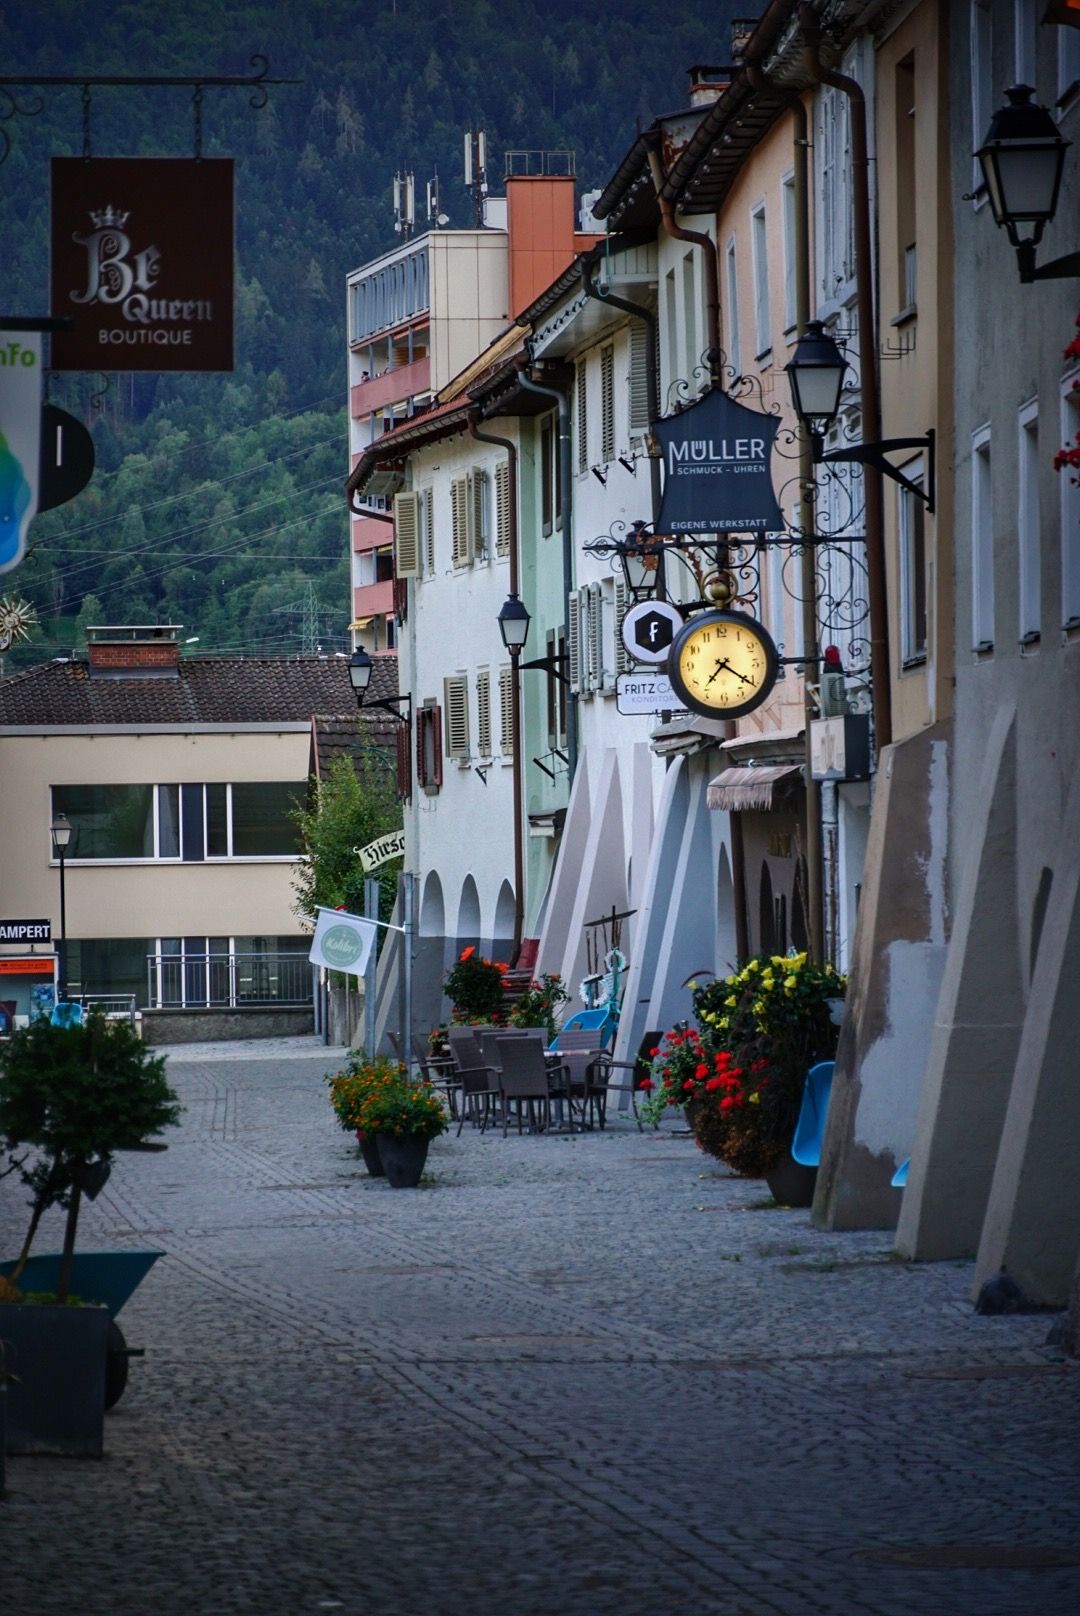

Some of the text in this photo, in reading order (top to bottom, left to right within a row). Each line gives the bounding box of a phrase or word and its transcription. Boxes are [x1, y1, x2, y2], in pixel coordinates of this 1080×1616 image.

[69, 229, 161, 305] Be
[122, 293, 212, 323] Queen
[98, 329, 192, 344] BOUTIQUE
[669, 438, 765, 475] MÜLLER
[677, 466, 722, 475] SCHMUCK
[734, 465, 765, 473] UHREN
[671, 519, 767, 529] EIGENE WERKSTATT
[703, 632, 710, 643] 11
[716, 626, 727, 638] 12
[690, 645, 700, 655] 10
[686, 661, 694, 671] 9
[625, 683, 655, 694] FRITZ
[720, 692, 728, 702] 6
